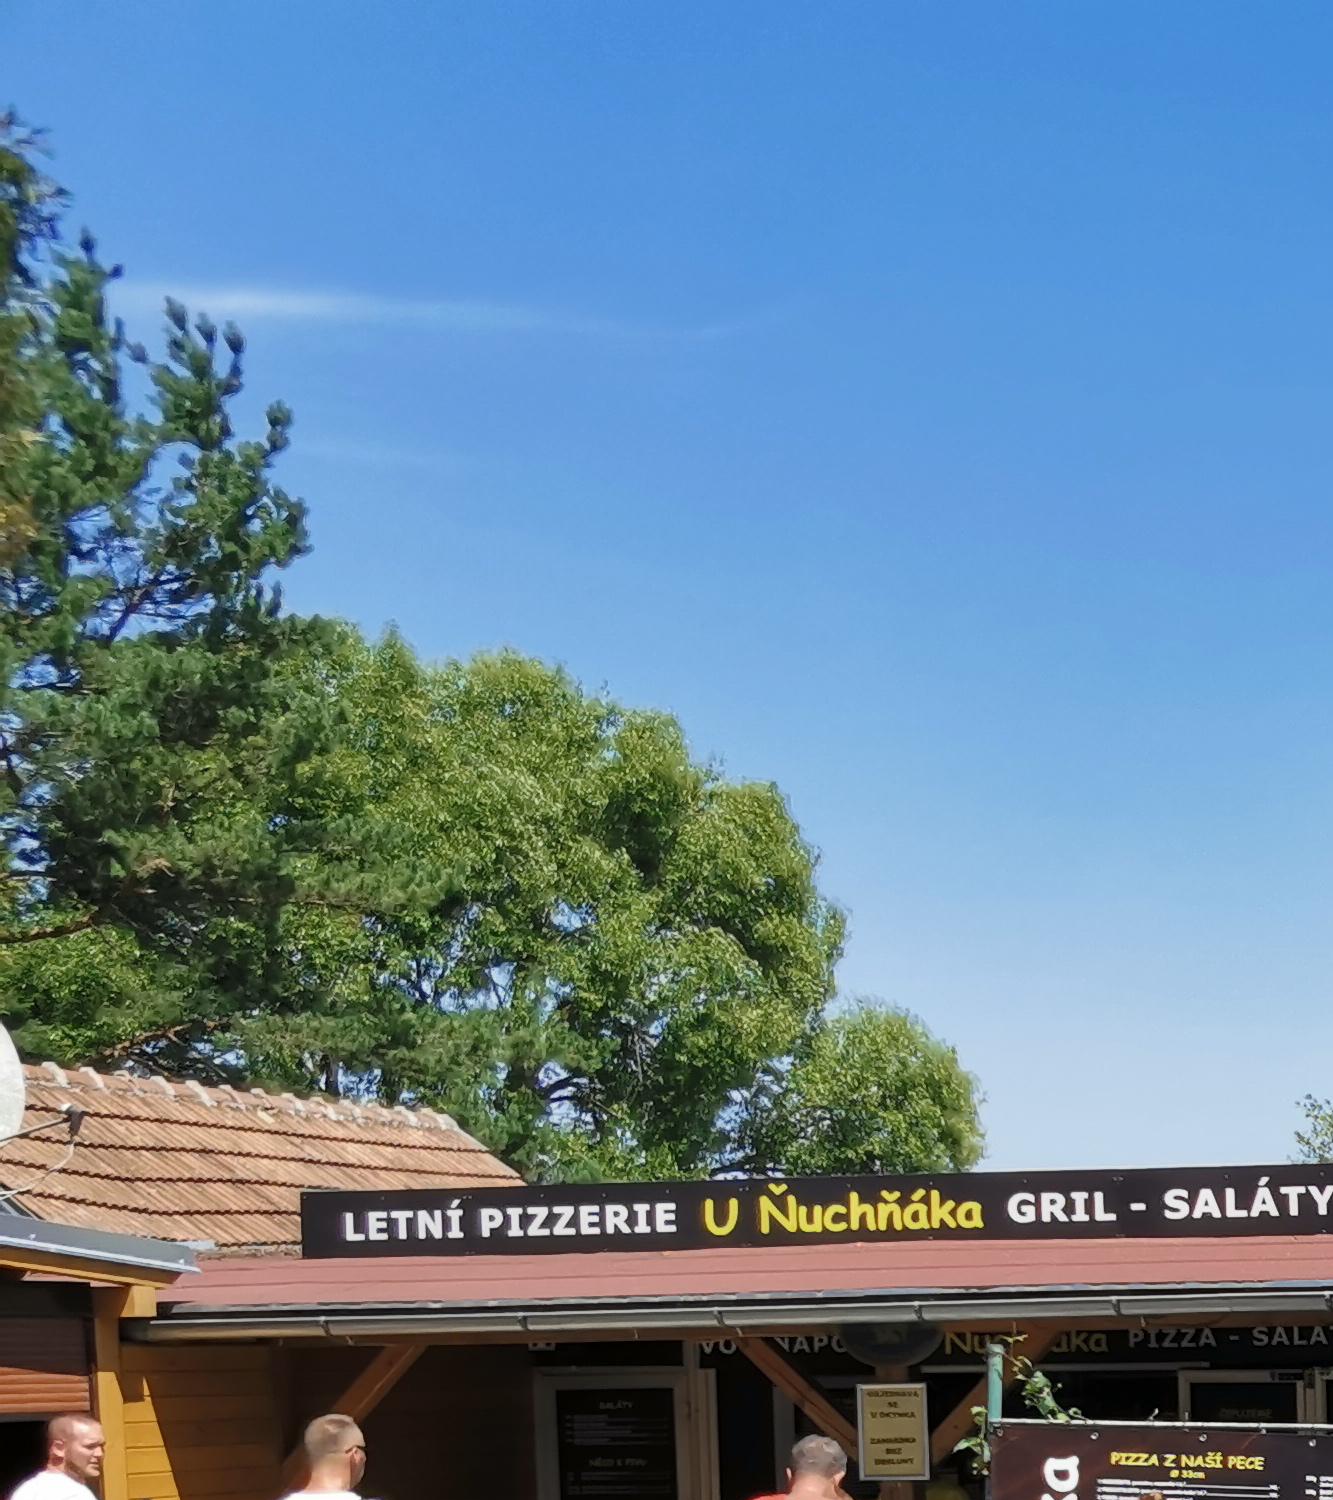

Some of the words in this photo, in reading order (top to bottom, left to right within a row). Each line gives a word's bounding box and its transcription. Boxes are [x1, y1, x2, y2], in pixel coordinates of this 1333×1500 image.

[344, 1200, 463, 1242] LETNÍ
[480, 1202, 678, 1239] PIZZERIE
[704, 1197, 739, 1237] U
[759, 1184, 985, 1236] Ňuchňáka
[1007, 1192, 1117, 1224] GRIL
[1127, 1328, 1218, 1350] PIZZA
[1110, 1452, 1160, 1467] PIZZA
[1163, 1454, 1177, 1468] Z
[1181, 1451, 1225, 1469] NAŠÍ
[1228, 1455, 1266, 1472] PECE
